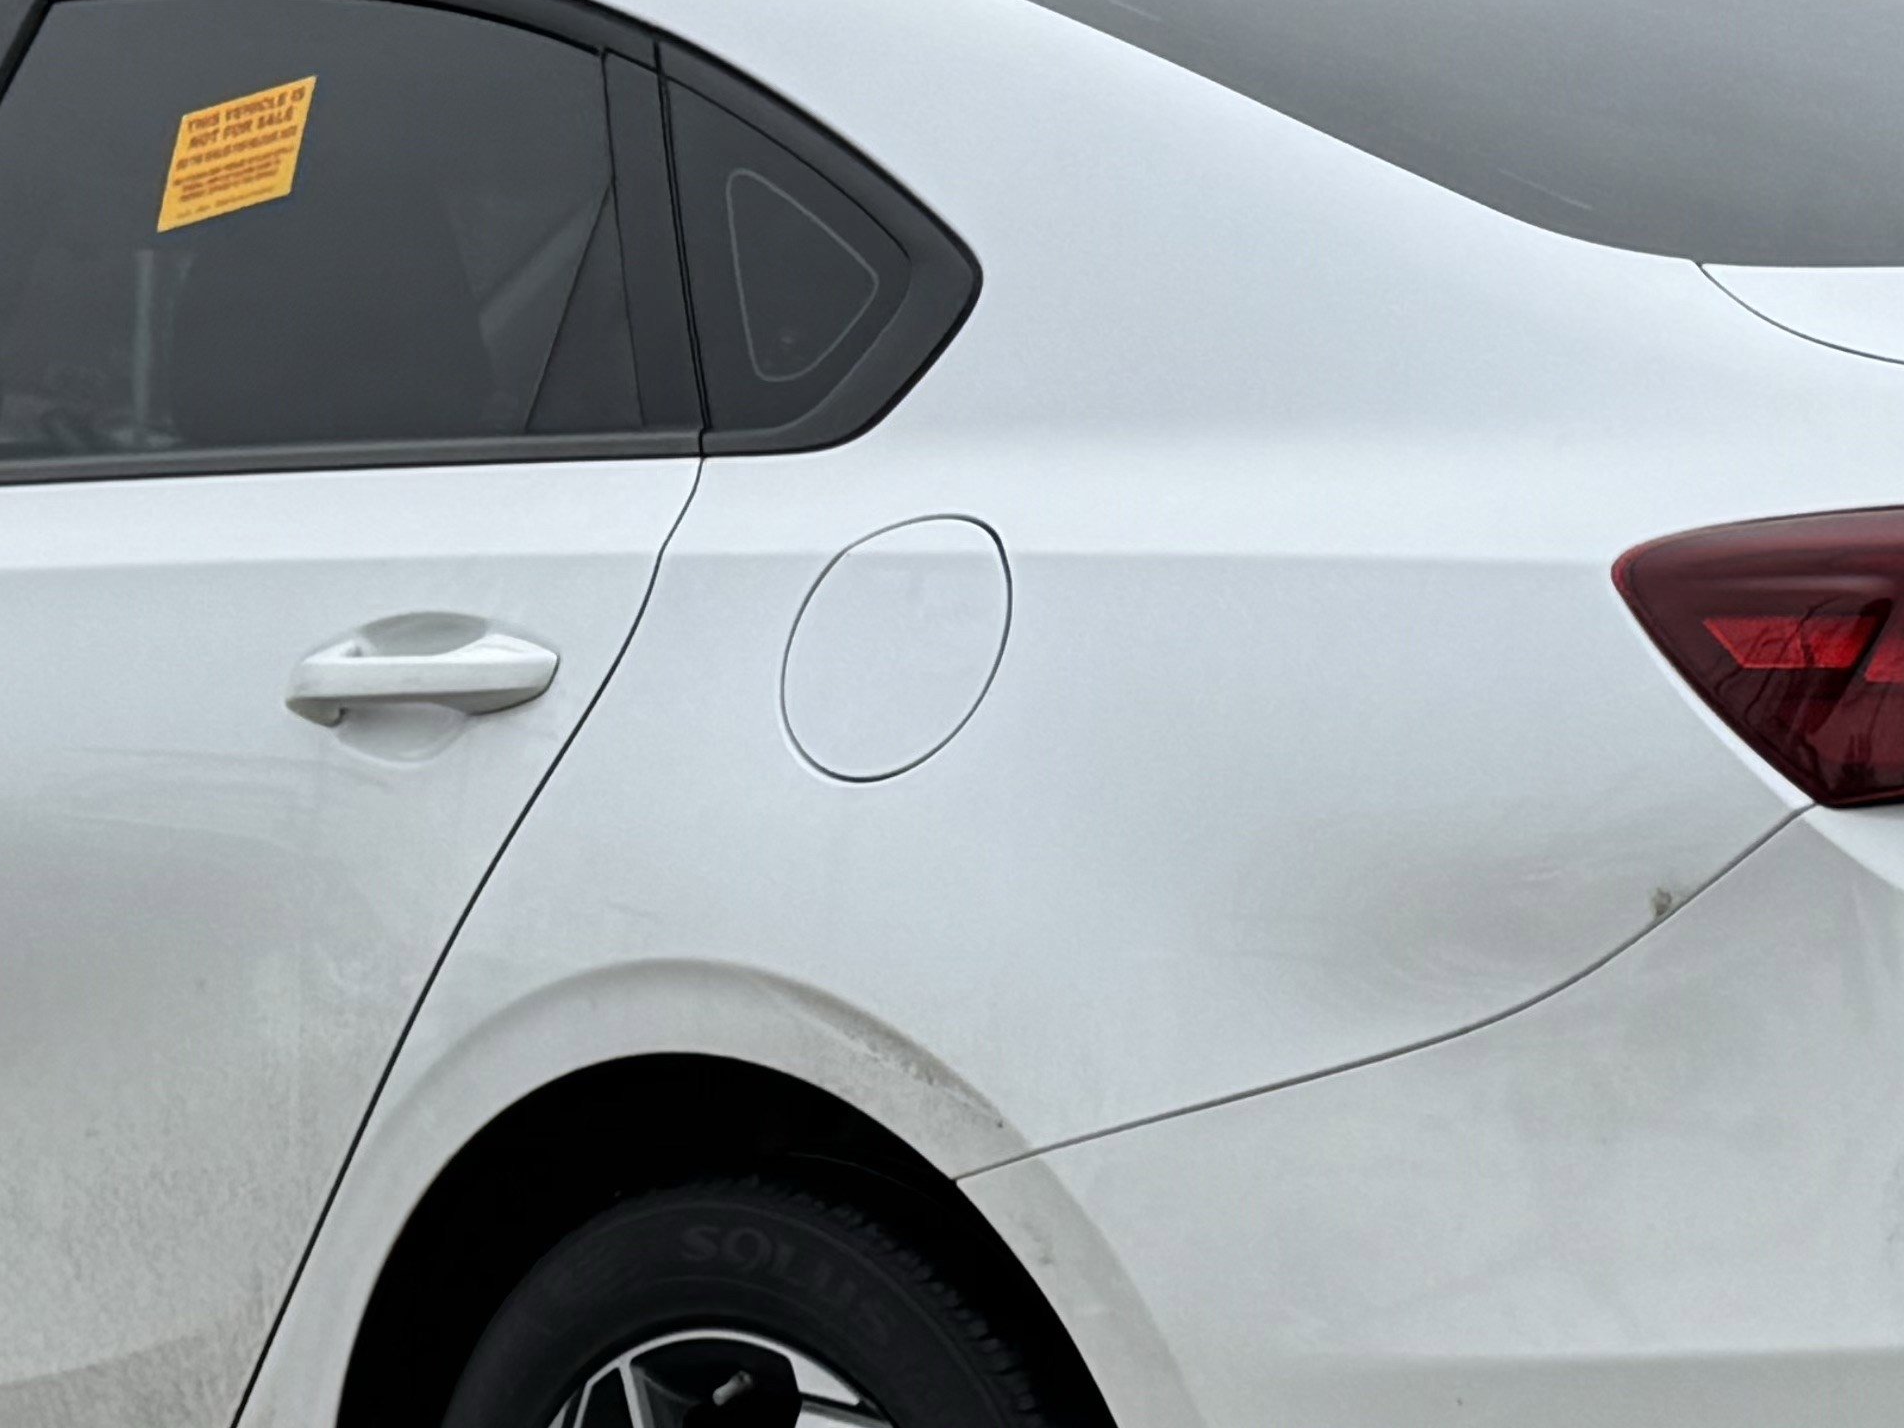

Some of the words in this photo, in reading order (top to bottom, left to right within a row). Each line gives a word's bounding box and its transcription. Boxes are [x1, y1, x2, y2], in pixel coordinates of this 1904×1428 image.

[226, 91, 288, 121] VEHICLE
[189, 128, 219, 149] NOT
[223, 120, 254, 140] FOR
[258, 105, 294, 130] SALE
